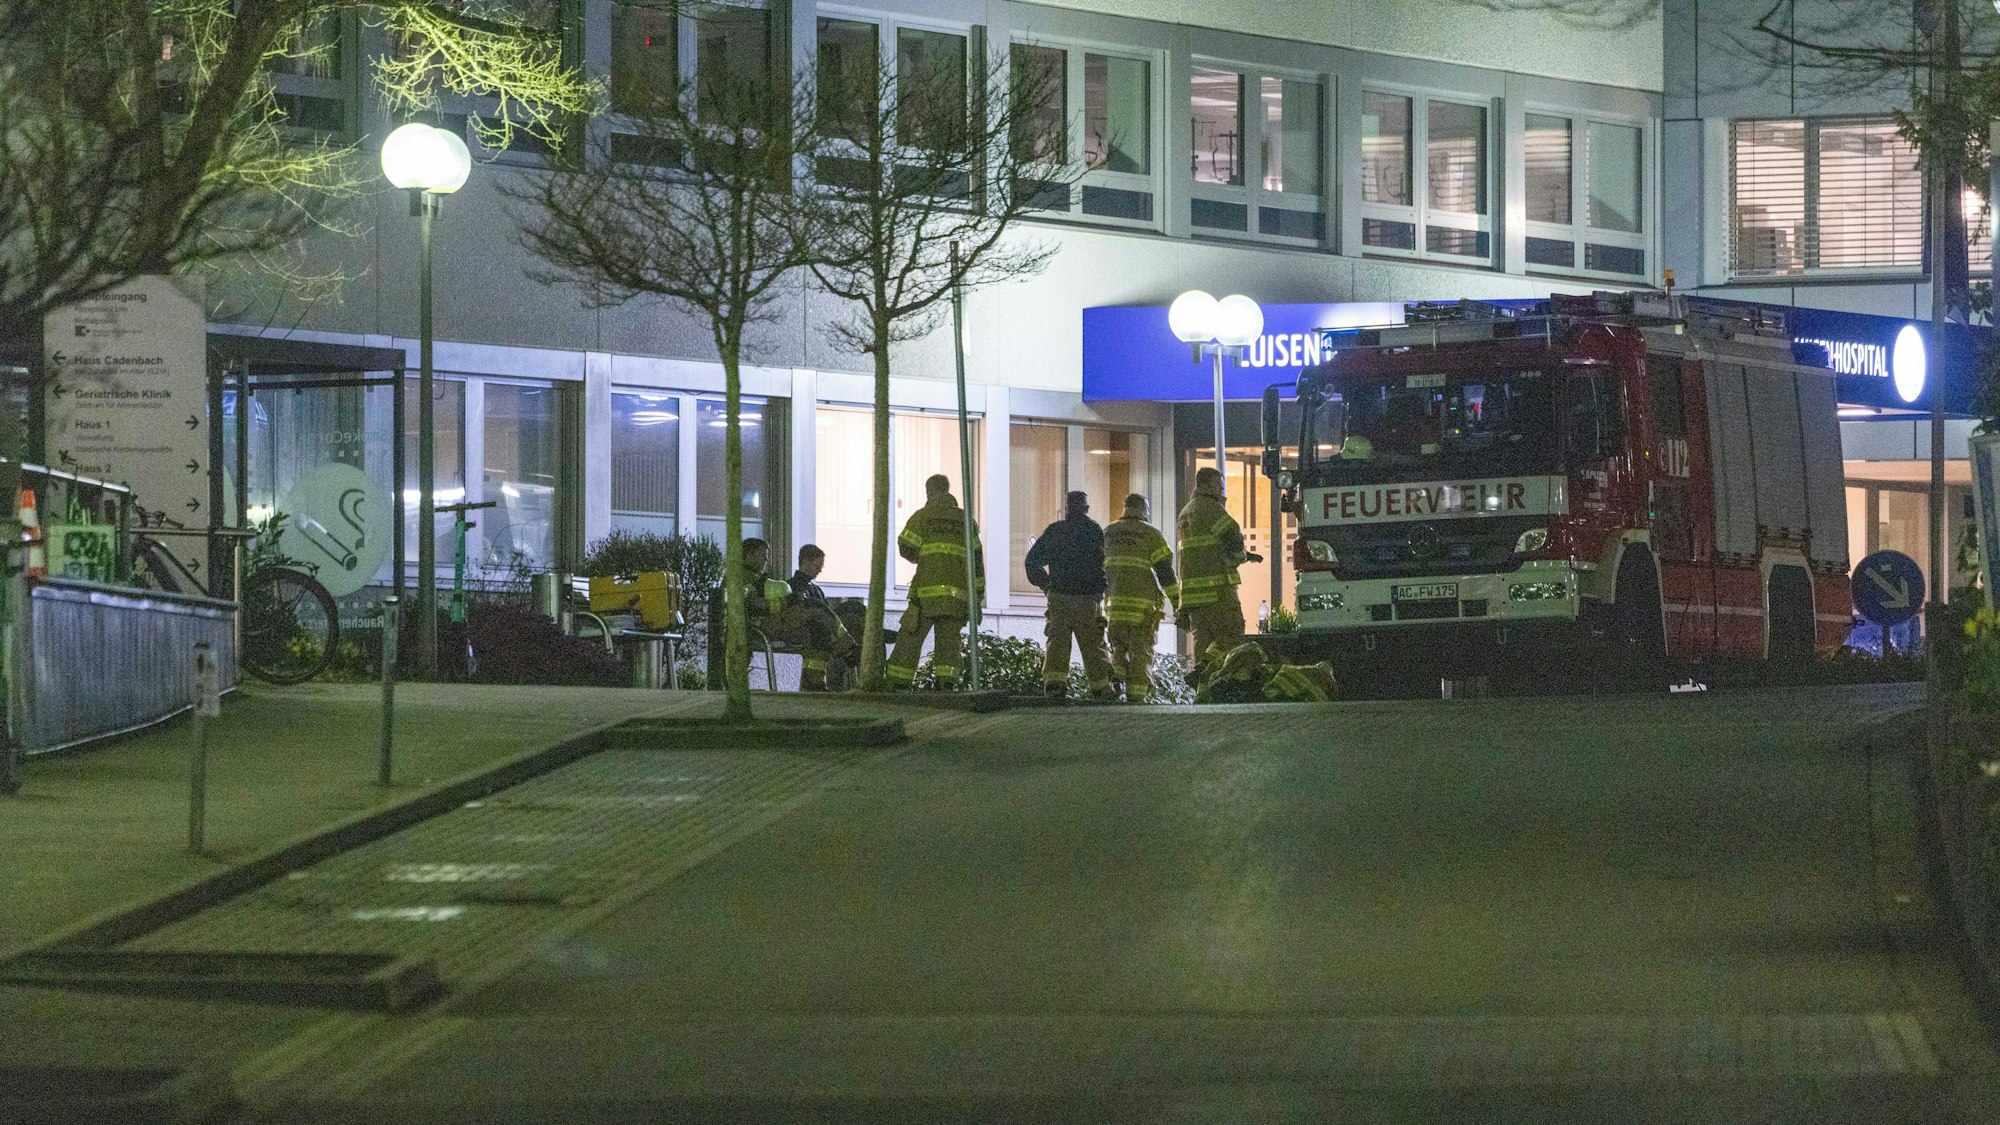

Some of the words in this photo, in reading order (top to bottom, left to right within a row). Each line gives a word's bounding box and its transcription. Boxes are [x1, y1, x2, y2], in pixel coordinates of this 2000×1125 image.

[75, 356, 101, 366] Haus
[104, 356, 163, 366] Cadenbach
[75, 390, 139, 400] Geriatrische
[142, 389, 171, 399] Klinik
[75, 421, 101, 429] Haus
[106, 420, 111, 429] 1
[1668, 439, 1690, 479] 112
[75, 464, 101, 473] Haus
[106, 464, 112, 473] 2
[1323, 483, 1526, 520] FEUERWEHR
[1399, 587, 1413, 599] AC
[1419, 586, 1434, 598] FW
[1435, 585, 1455, 597] 175
